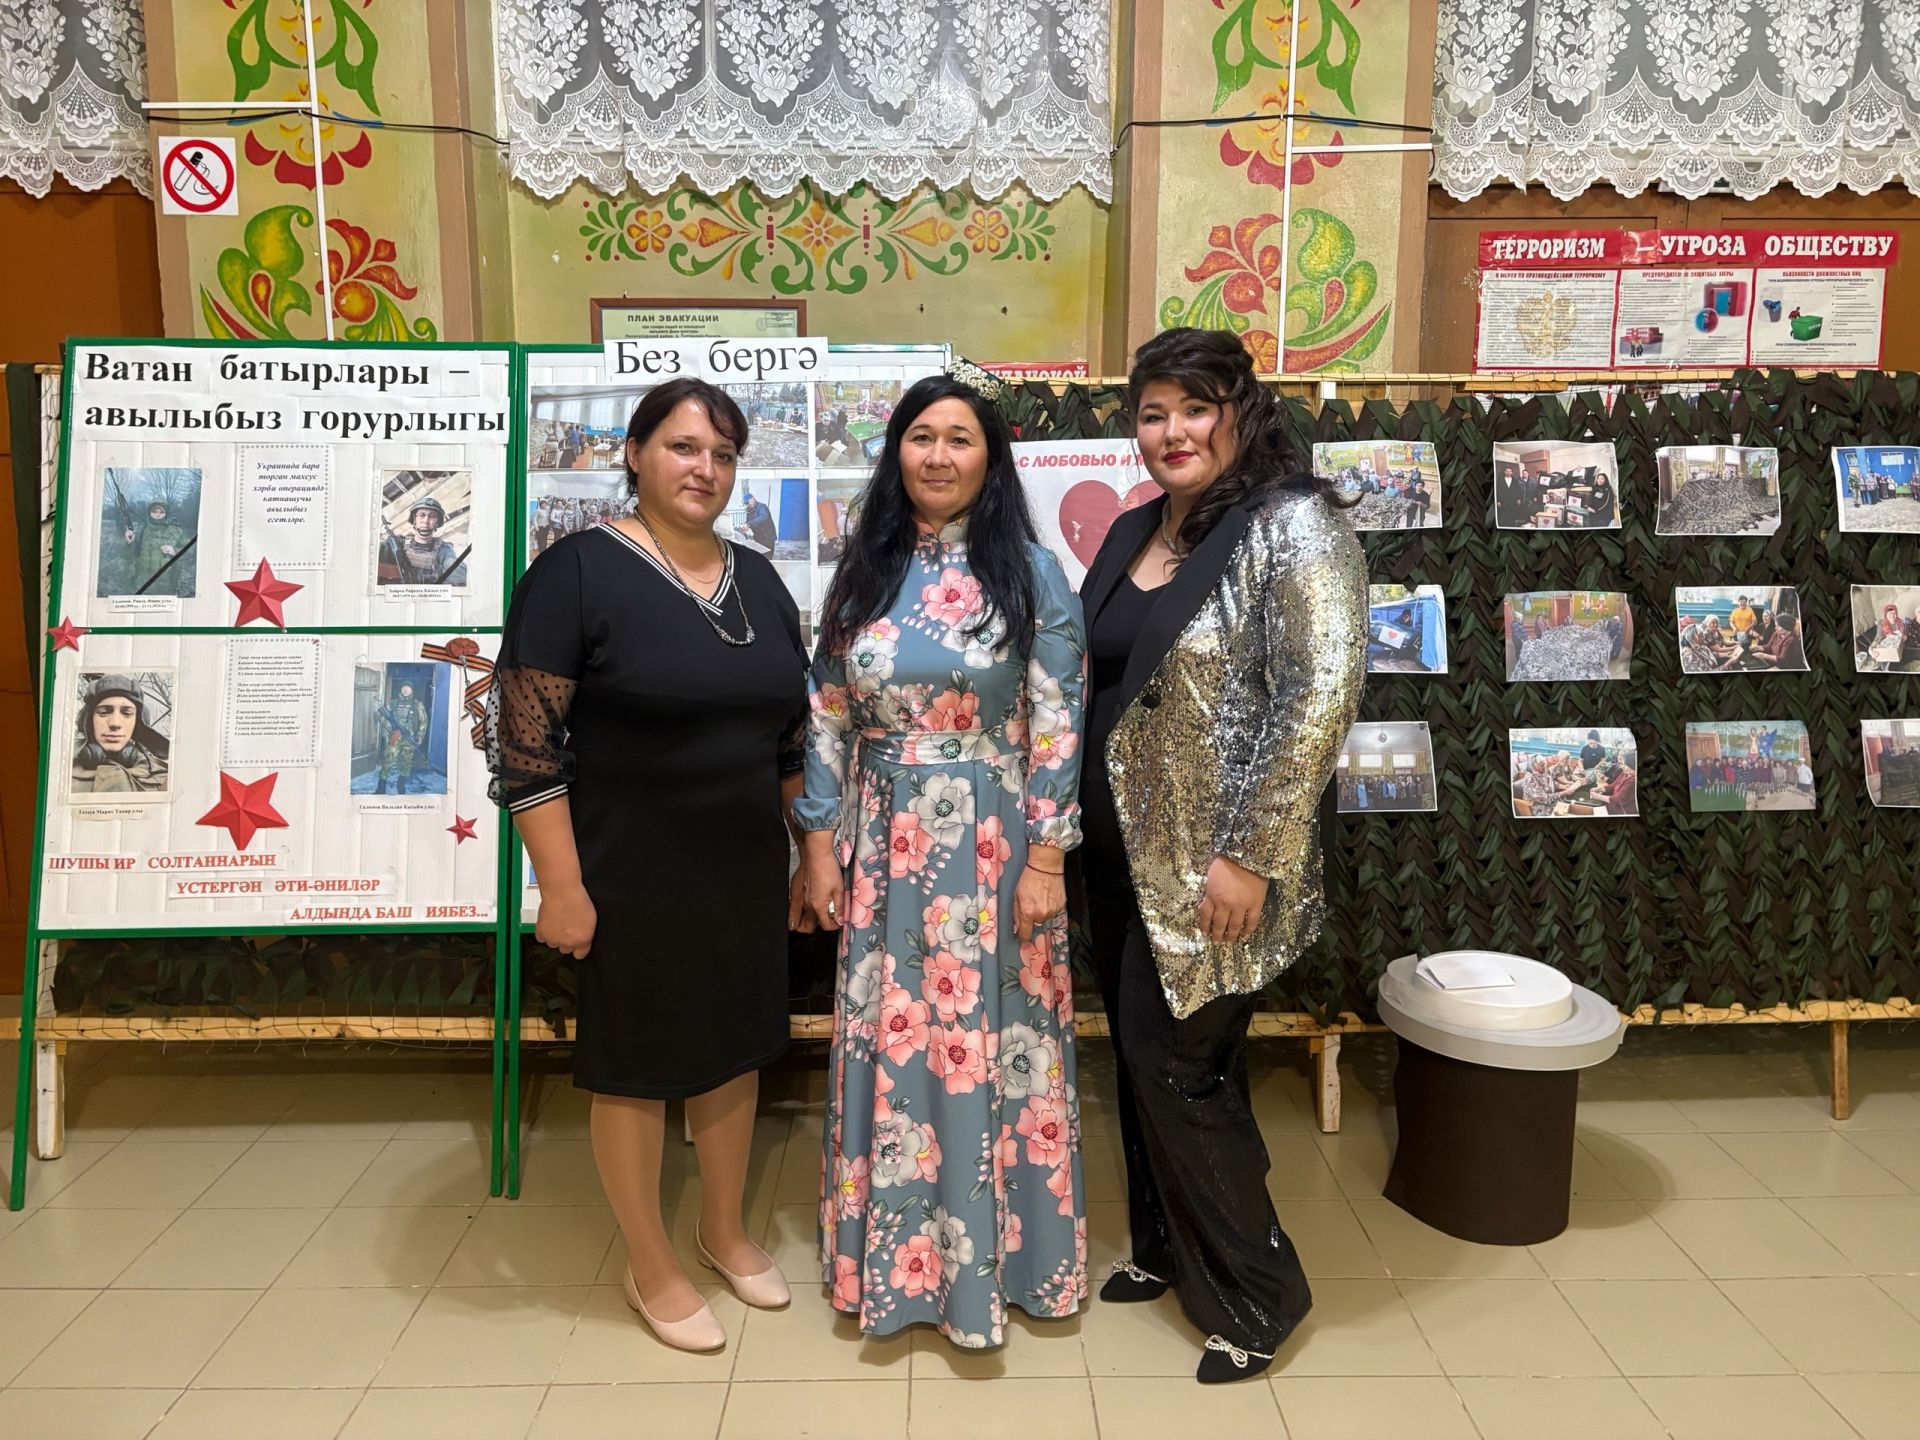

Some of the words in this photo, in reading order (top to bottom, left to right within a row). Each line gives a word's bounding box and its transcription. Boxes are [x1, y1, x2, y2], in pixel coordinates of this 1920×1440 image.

[1492, 237, 1606, 260] ТЕРРОРИЗМ
[1660, 235, 1747, 256] УГРОЗА
[1764, 235, 1894, 260] ОБЩЕСТВУ
[627, 314, 655, 323] ПЛАН
[658, 314, 719, 323] ЭВАКУАЦИИ
[614, 341, 681, 374] Без
[709, 340, 818, 381] бергә
[85, 353, 192, 382] Ватан
[220, 354, 429, 391] батырлары
[85, 402, 282, 430] авылыбыз
[302, 410, 505, 440] горурлыгы
[256, 462, 300, 471] Украинада
[301, 462, 320, 471] бара
[1032, 454, 1117, 468] ЛЮБОВЬЮ
[258, 474, 288, 482] торган
[289, 474, 318, 482] махсус
[262, 496, 312, 504] катнашучы
[49, 857, 110, 870] ШУШЫ
[113, 858, 136, 870] ИР
[147, 854, 276, 869] СОЛТАННАРЫН
[176, 880, 263, 894] ҮСТЕРГӘН
[274, 879, 380, 892] ӘТИ-ӘНИЛӘР
[290, 907, 372, 922] АЛДЫНДА
[376, 906, 413, 919] БАШ
